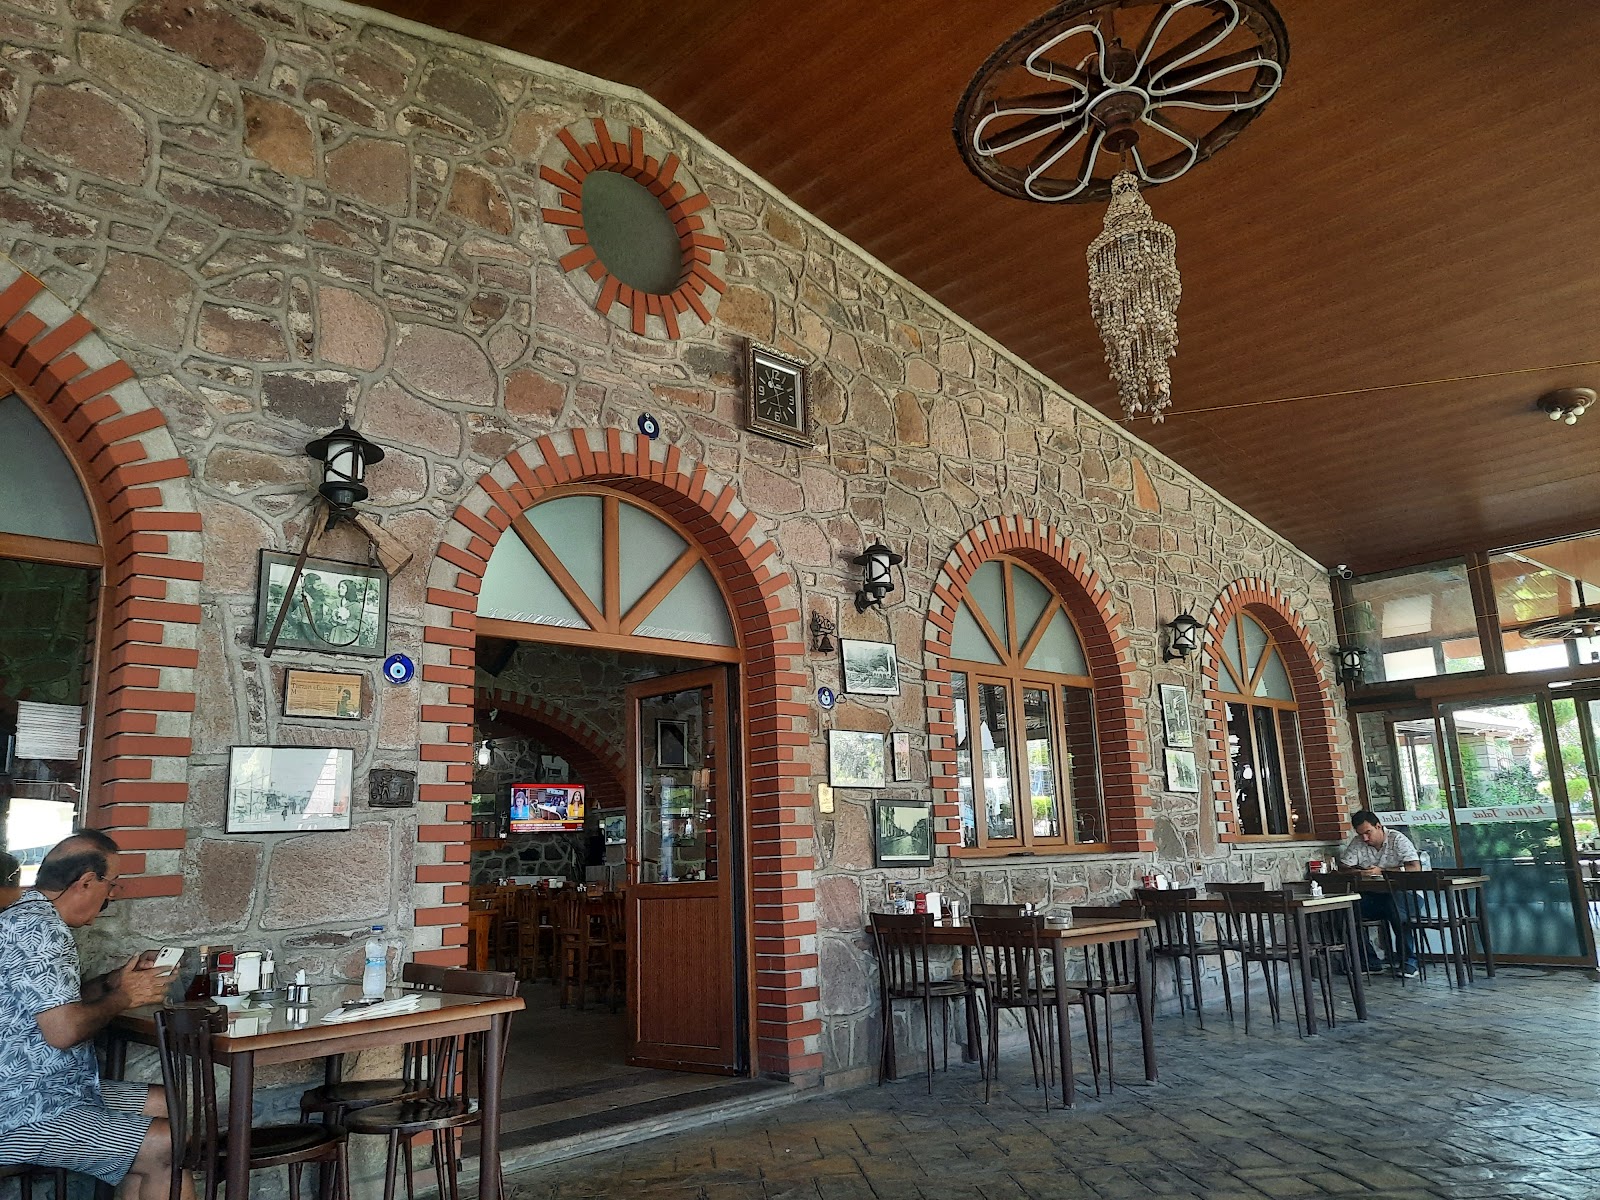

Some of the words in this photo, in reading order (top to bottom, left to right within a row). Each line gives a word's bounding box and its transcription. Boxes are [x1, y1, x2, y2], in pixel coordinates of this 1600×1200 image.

[772, 369, 780, 380] 12
[758, 385, 764, 396] 9
[789, 395, 794, 405] 3
[774, 411, 780, 421] 6
